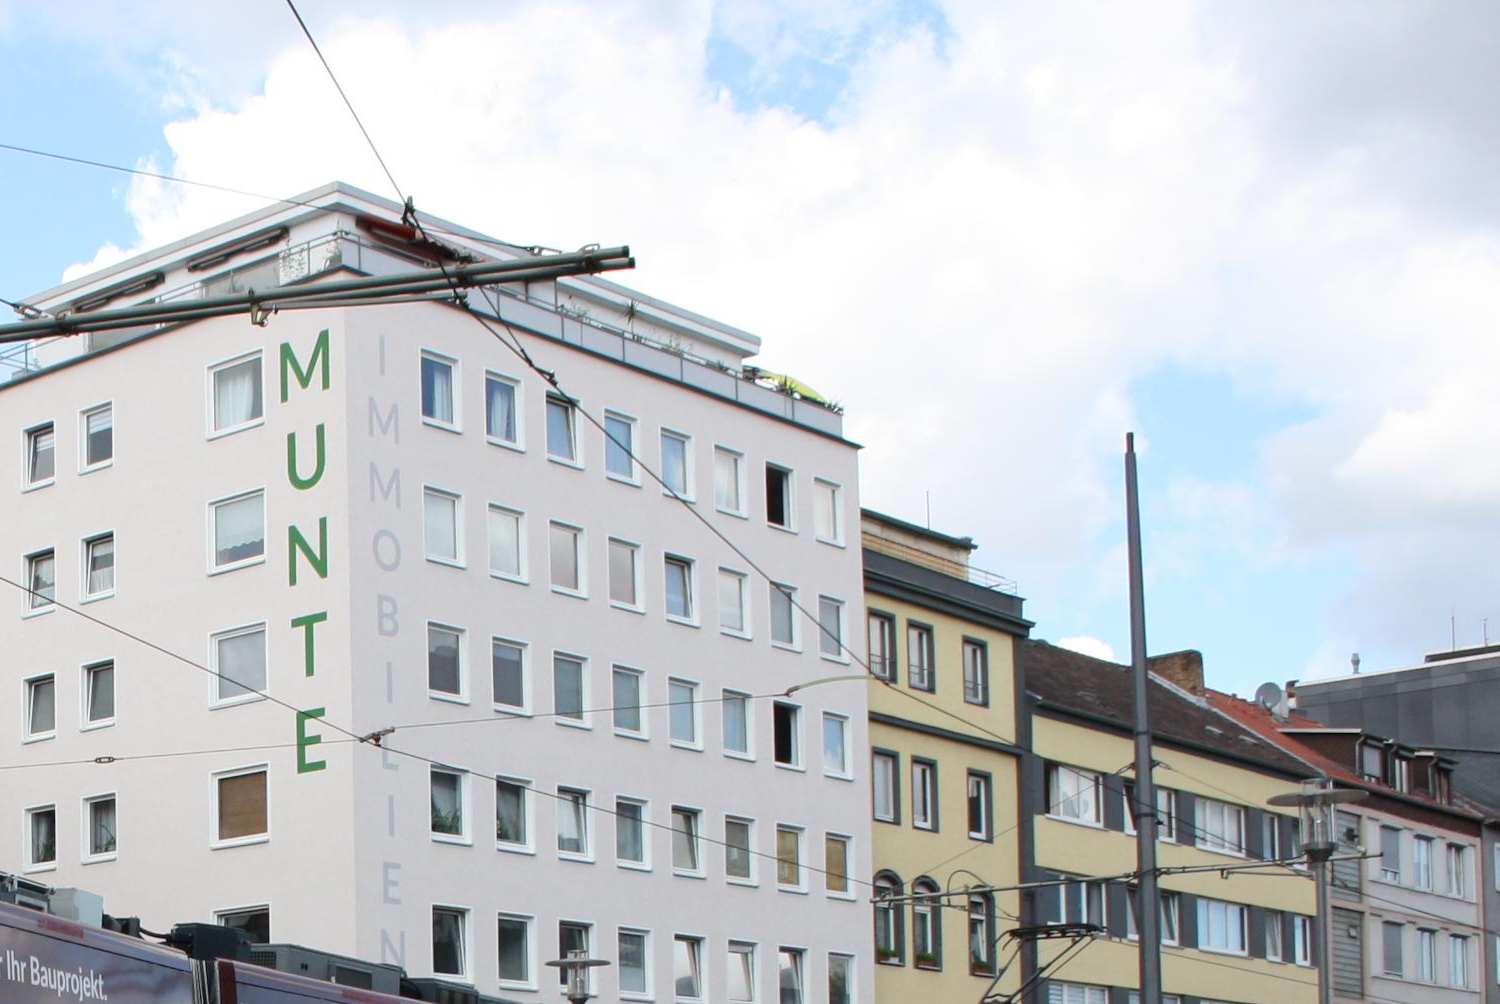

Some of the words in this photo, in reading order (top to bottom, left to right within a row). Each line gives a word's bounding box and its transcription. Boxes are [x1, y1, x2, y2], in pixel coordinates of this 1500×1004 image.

[280, 328, 330, 775] MUNTE
[367, 335, 406, 971] IMMOBILIEN
[6, 949, 27, 983] Ihr
[29, 955, 108, 1001] Bauprojekt.
